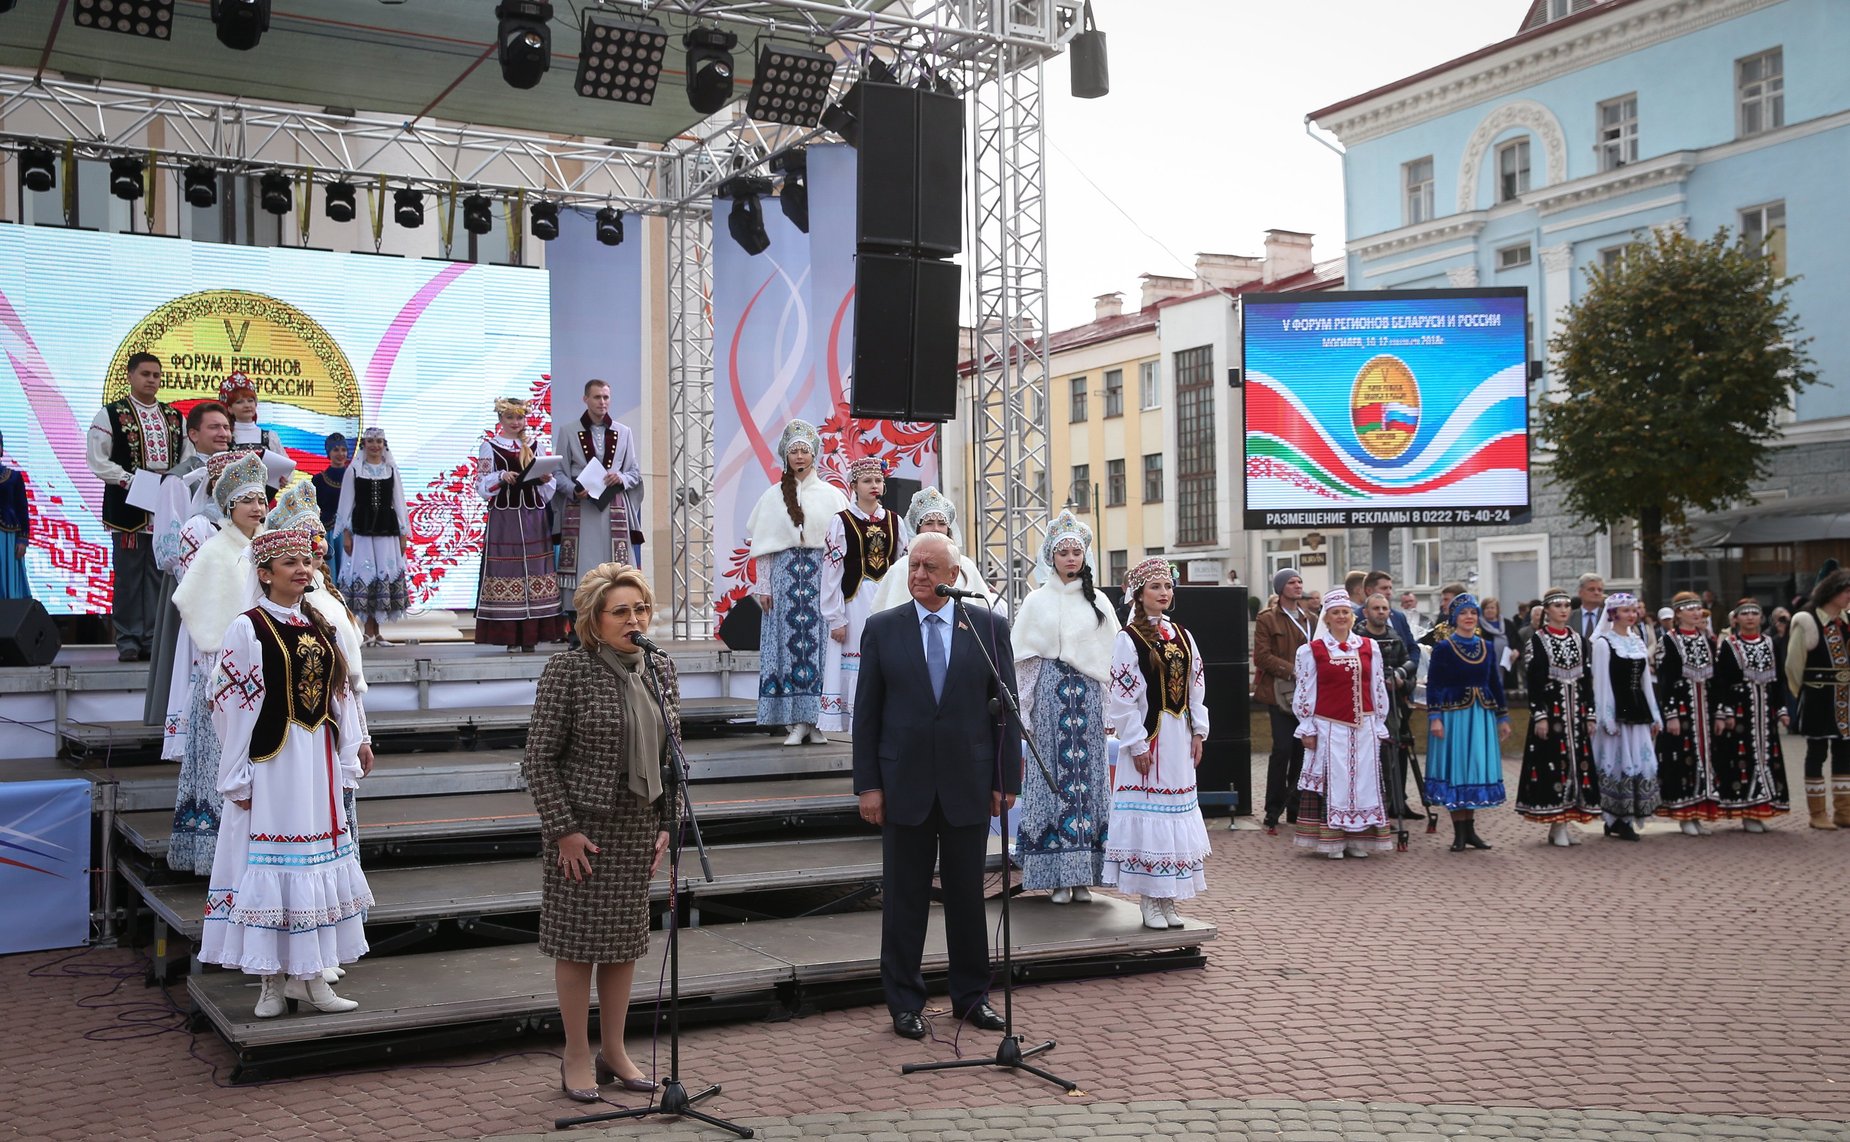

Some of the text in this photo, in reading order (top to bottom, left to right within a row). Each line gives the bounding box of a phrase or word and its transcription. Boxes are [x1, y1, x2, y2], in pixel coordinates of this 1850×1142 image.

[1282, 314, 1501, 331] V ФОРУМ РЕГИОНОВ БЕЛАРУСИ И РОССИИ
[223, 319, 250, 352] V
[171, 353, 302, 375] ФОРУМ РЕГИОНОВ
[255, 377, 315, 397] РОССИИ
[1266, 509, 1511, 526] РАЗМЕЩЕНИЕ РЕКЛАМЫ 8 0222 76-40-24
